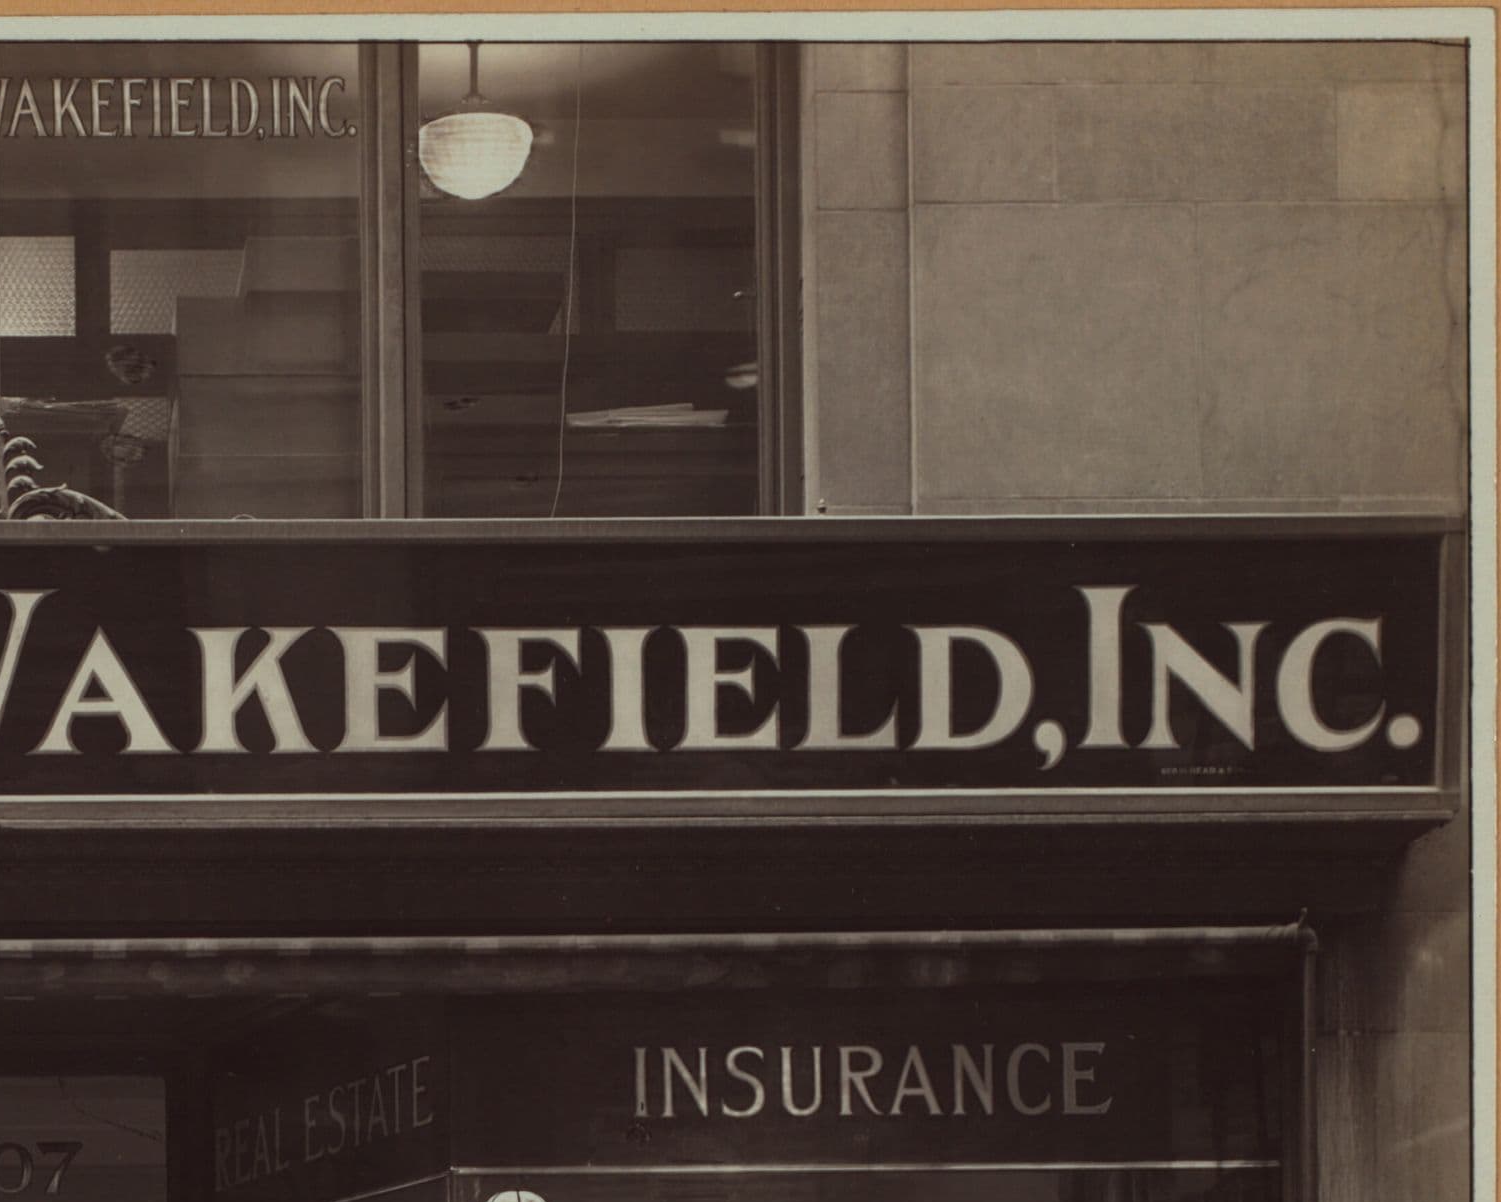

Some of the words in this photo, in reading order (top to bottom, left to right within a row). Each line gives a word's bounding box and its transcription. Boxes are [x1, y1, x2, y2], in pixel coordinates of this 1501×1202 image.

[214, 1106, 292, 1193] REAL
[304, 1054, 435, 1164] ESTATE
[633, 1041, 1113, 1119] INSURANCE
